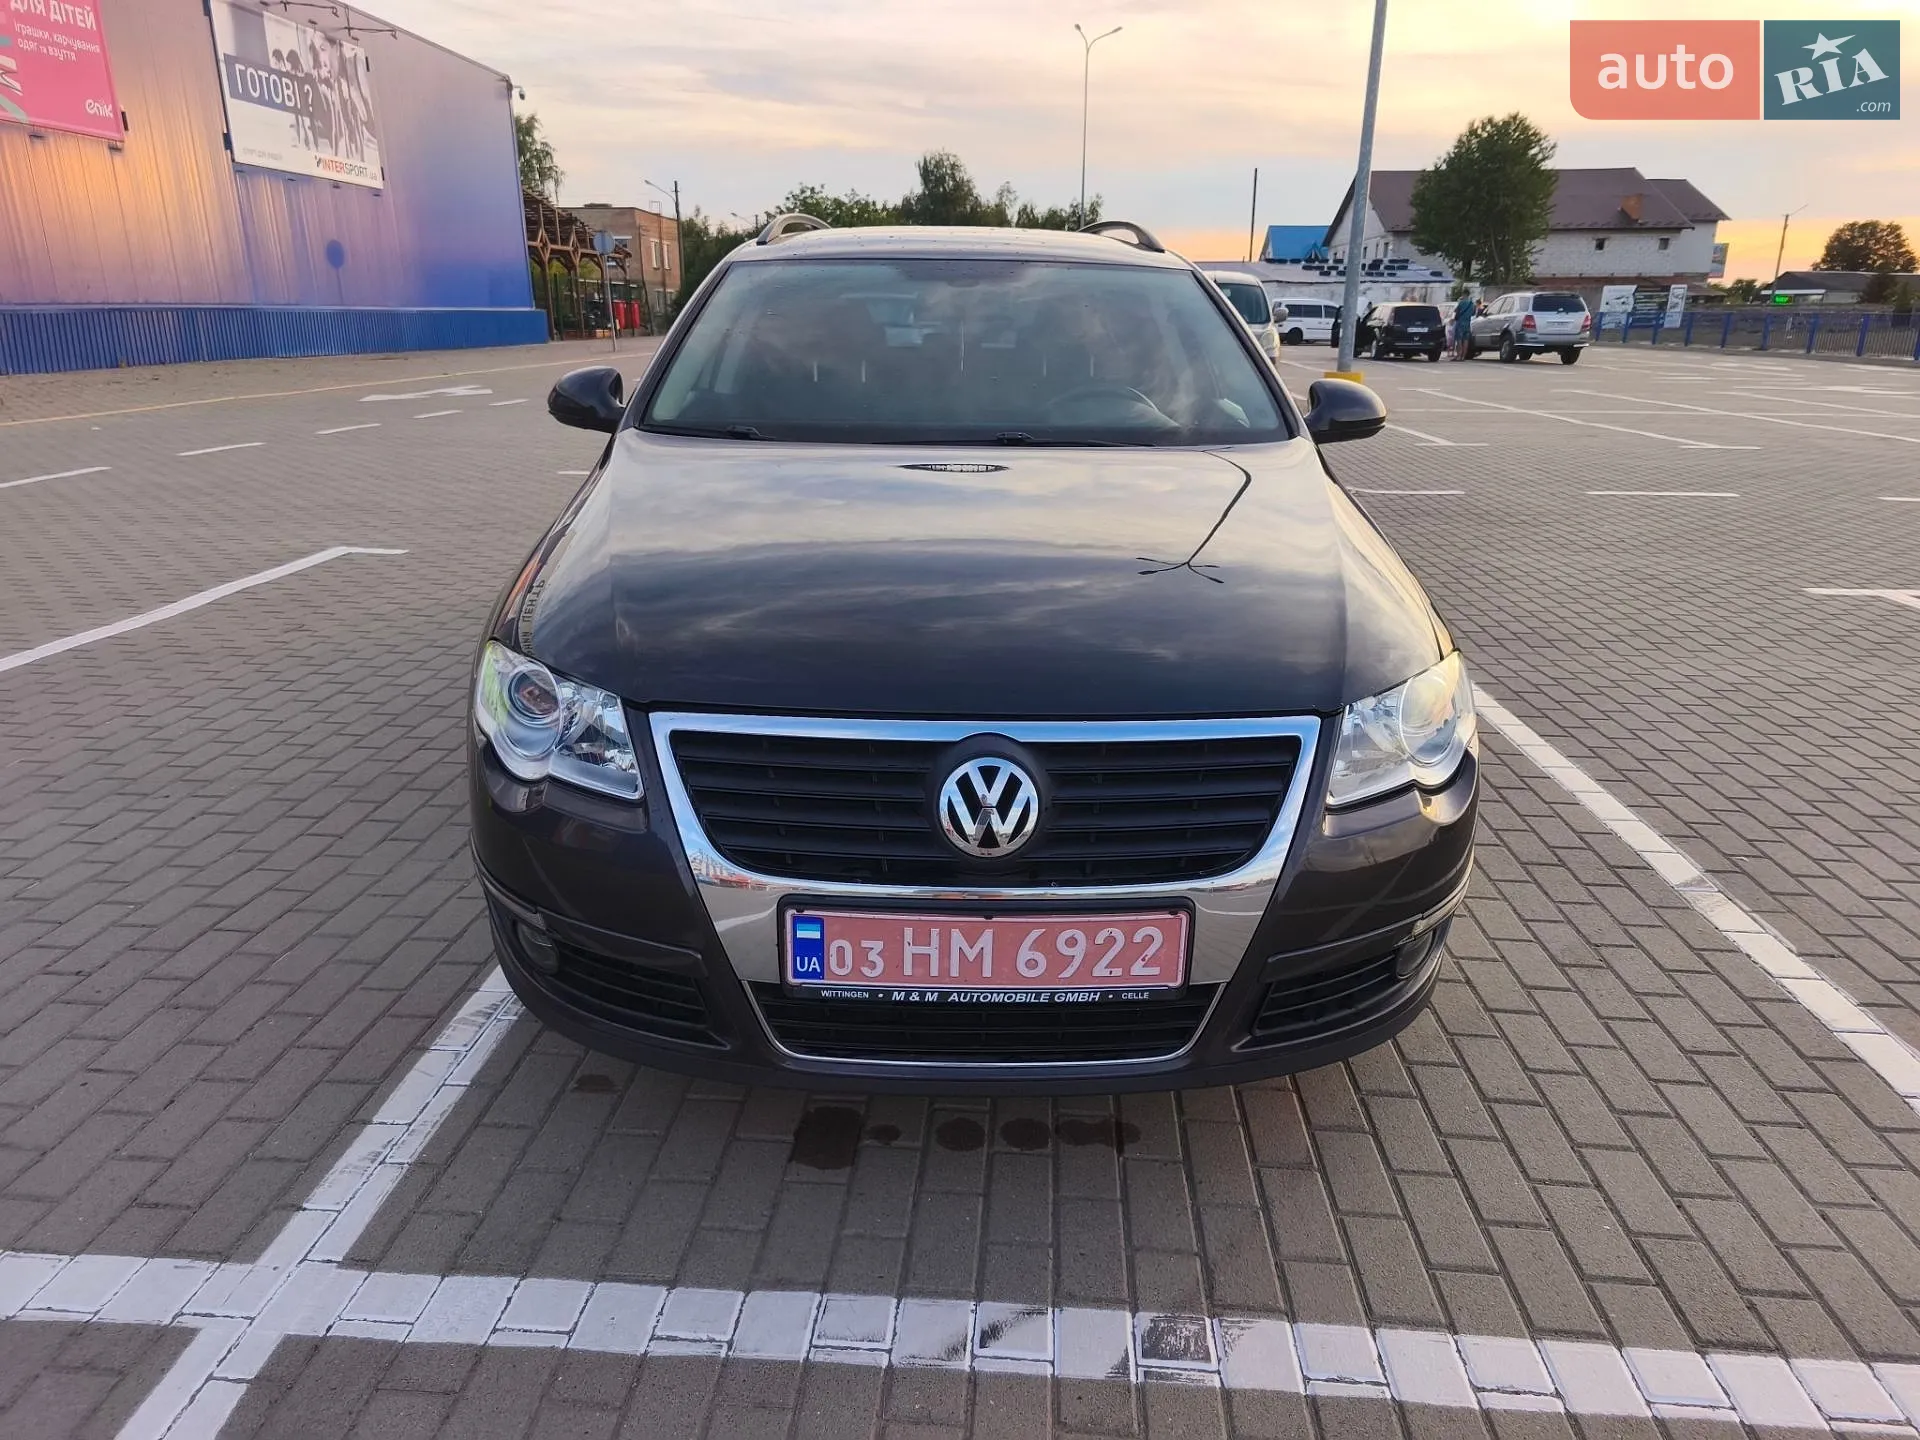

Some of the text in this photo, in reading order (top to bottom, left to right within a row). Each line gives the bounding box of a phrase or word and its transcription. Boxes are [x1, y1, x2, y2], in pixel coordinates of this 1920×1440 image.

[49, 0, 97, 31] ДІТЕЙ
[17, 38, 77, 62] одяг та взуття
[796, 956, 821, 974] UA
[829, 926, 1165, 980] 03 HM 6922
[821, 990, 1149, 1003] WITTINGEN M & M AUTOMOBILE GMBH CELLE
